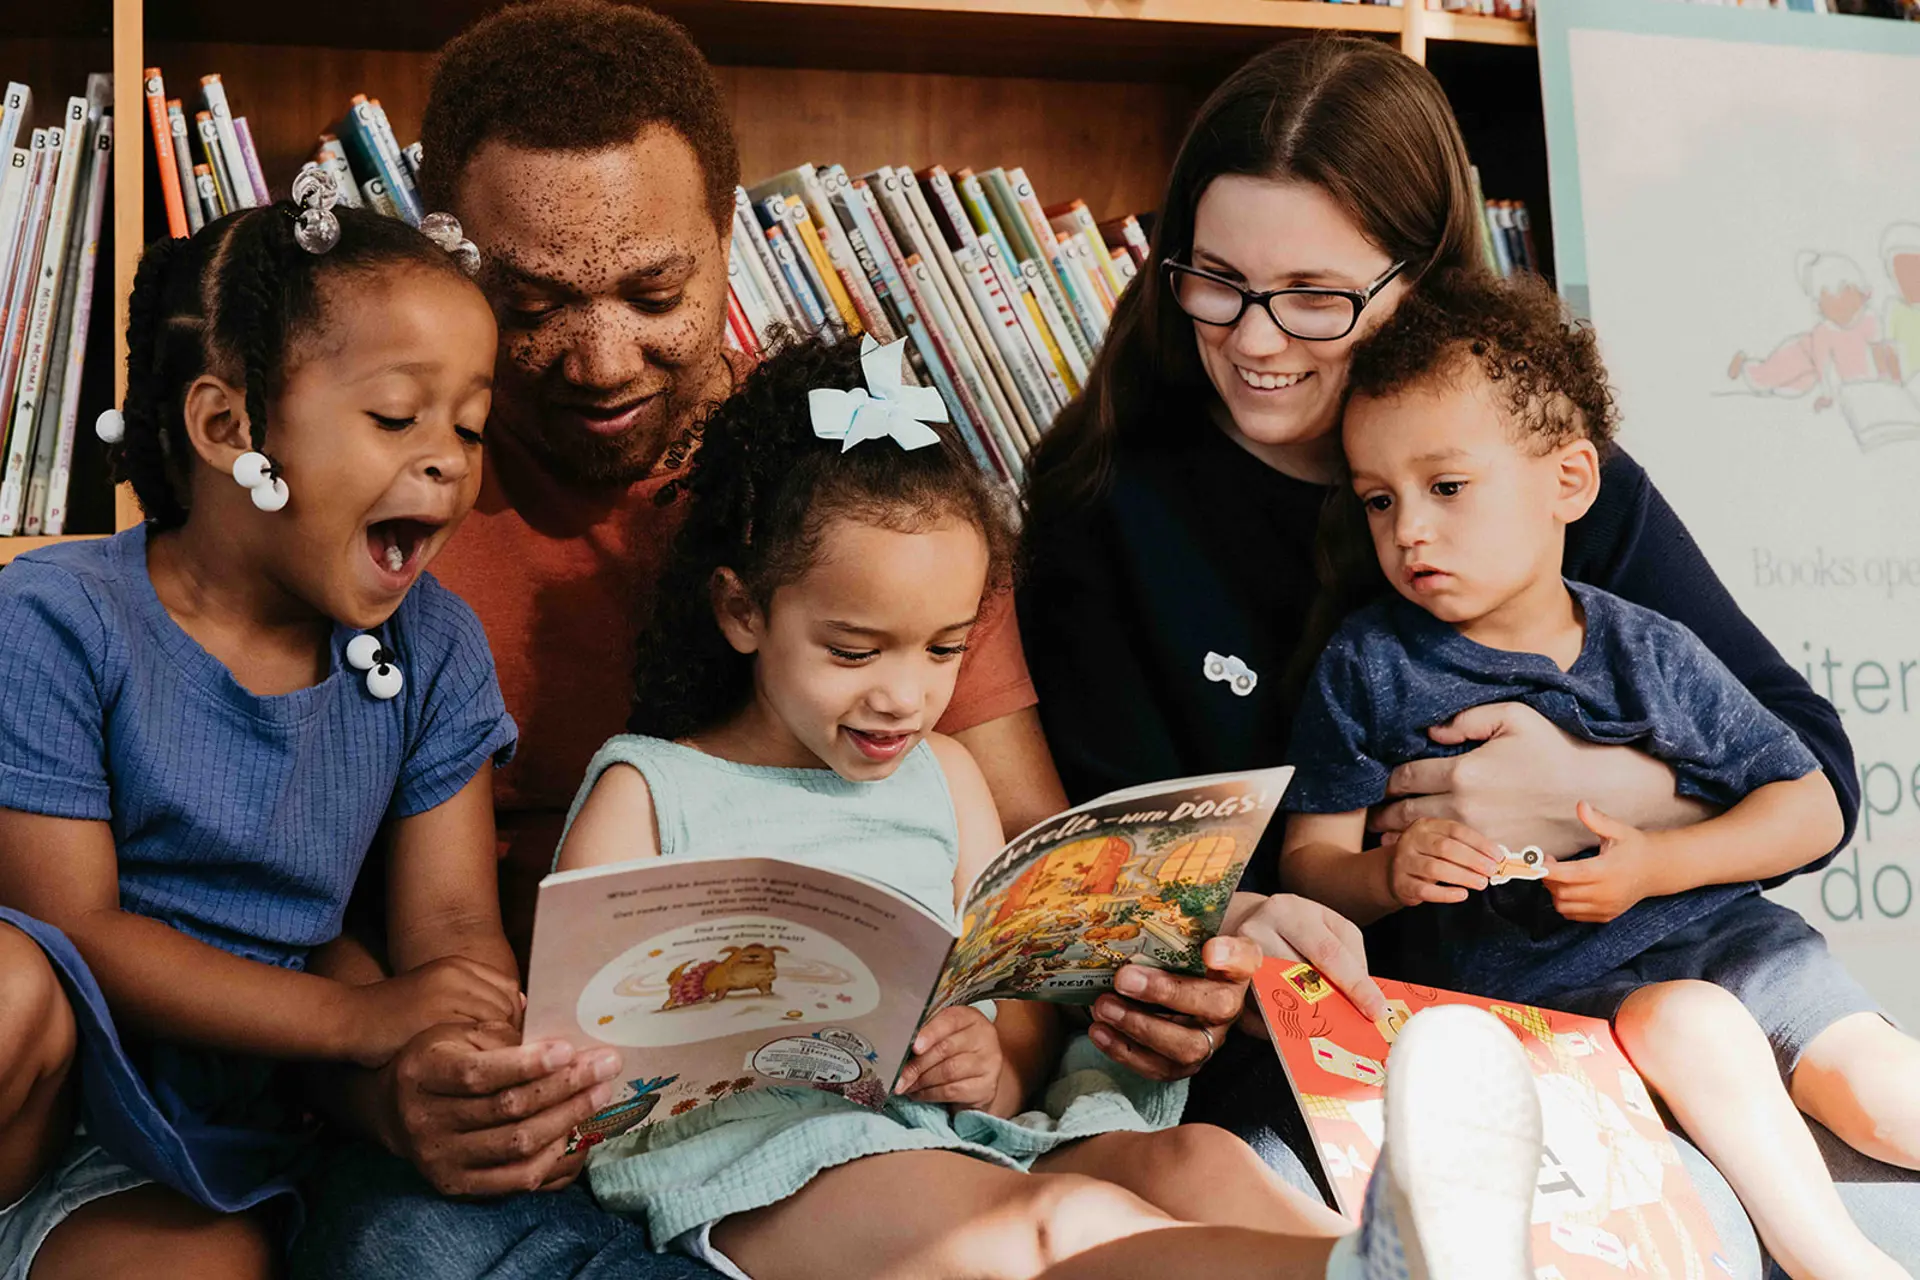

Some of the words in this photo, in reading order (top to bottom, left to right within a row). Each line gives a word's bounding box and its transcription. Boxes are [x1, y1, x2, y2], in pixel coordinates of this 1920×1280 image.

[71, 105, 83, 120] B
[98, 135, 110, 151] B
[12, 153, 25, 168] B
[371, 179, 385, 195] C
[884, 177, 898, 191] C
[901, 173, 914, 188] C
[1018, 183, 1030, 197] C
[986, 244, 999, 258] C
[1025, 264, 1039, 278] C
[34, 287, 51, 339] MISSING
[25, 343, 41, 393] MOMMA
[28, 516, 39, 527] P
[1752, 546, 1857, 588] Books
[1803, 641, 1917, 714] iter
[1168, 790, 1267, 822] DOGS!
